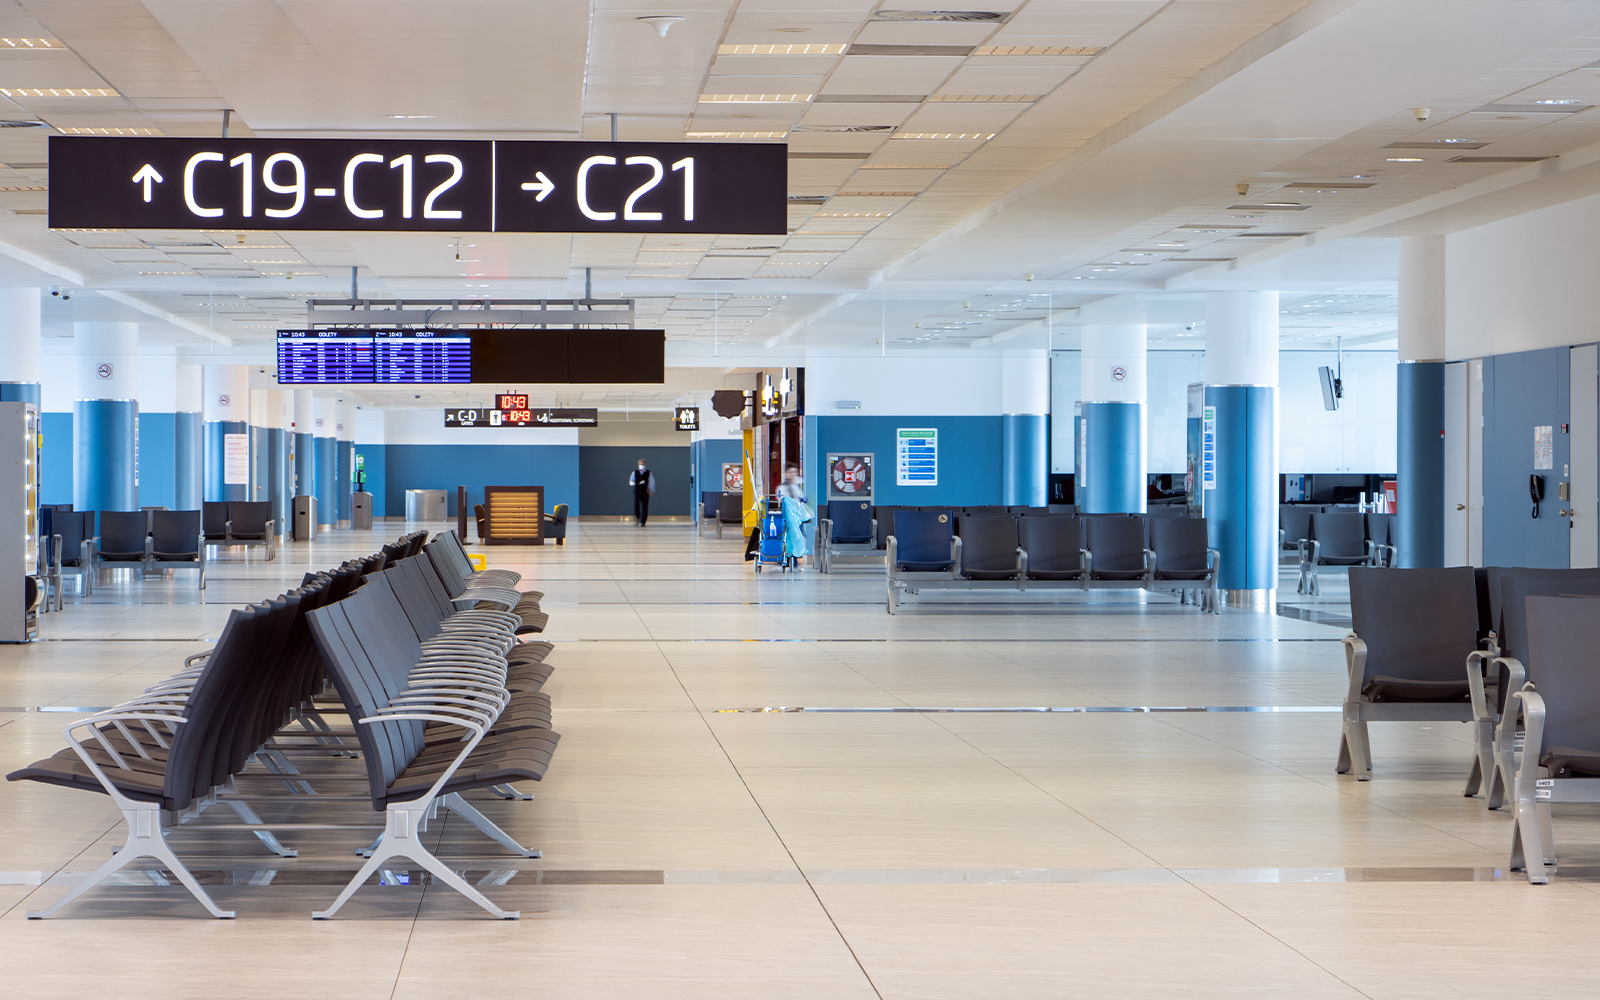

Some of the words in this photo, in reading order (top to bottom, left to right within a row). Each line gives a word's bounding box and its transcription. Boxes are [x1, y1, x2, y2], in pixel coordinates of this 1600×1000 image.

[183, 151, 464, 221] C19-C12
[576, 155, 696, 222] C21
[501, 396, 526, 409] 10:43
[457, 410, 477, 421] C-D
[510, 410, 531, 421] 10:43
